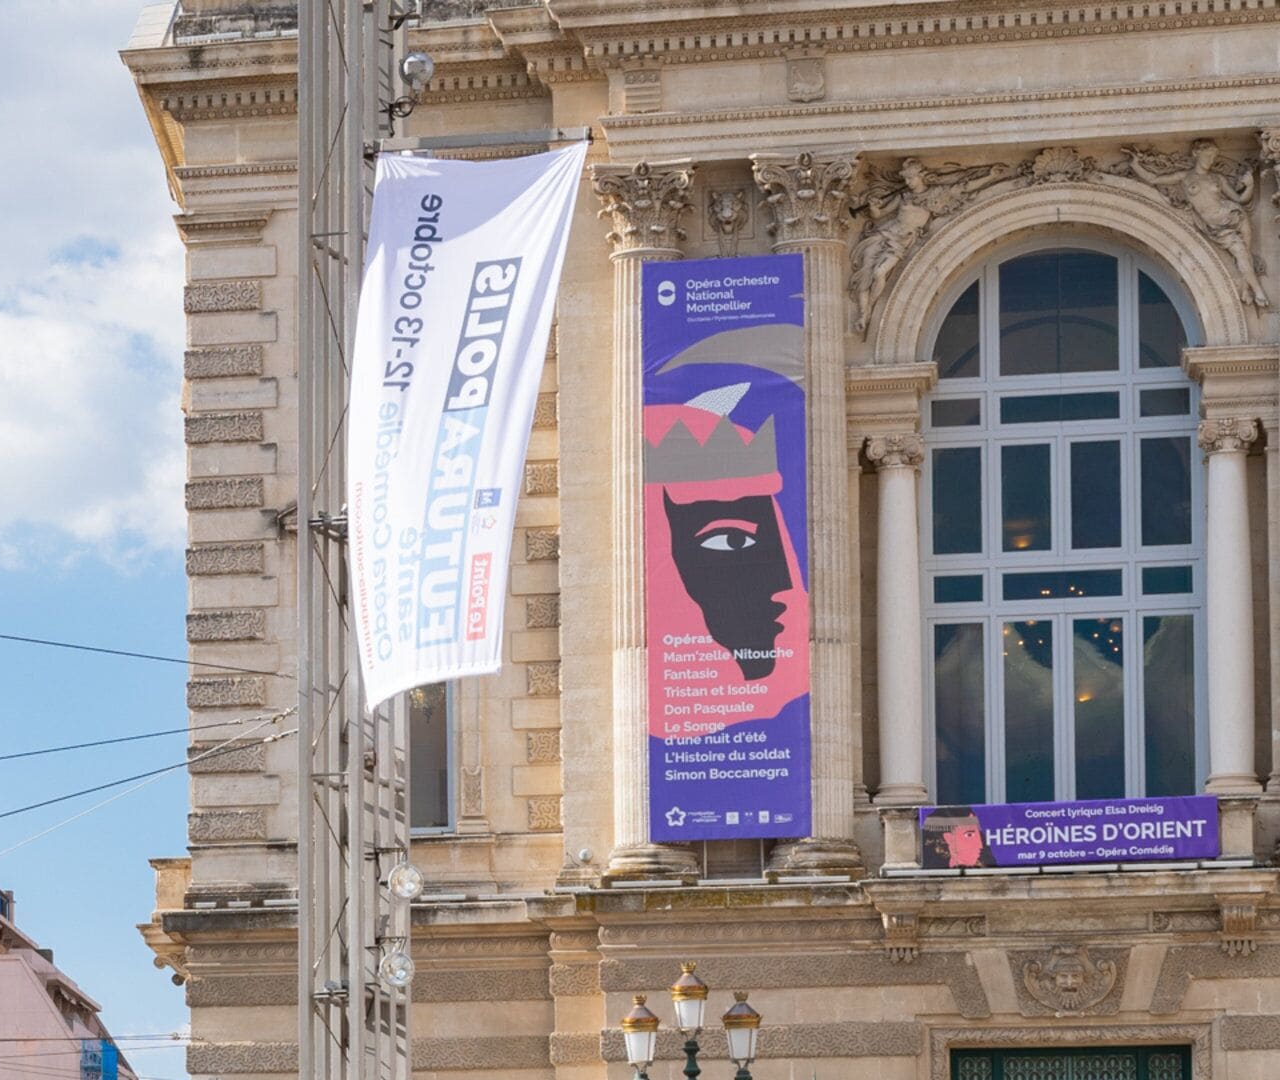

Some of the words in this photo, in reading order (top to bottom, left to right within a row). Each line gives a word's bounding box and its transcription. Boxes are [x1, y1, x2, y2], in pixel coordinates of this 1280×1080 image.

[686, 278, 721, 290] Opéra
[723, 275, 780, 287] Orchestre
[686, 289, 734, 301] National
[686, 301, 752, 313] Montpellier
[663, 634, 714, 647] Opéras
[733, 647, 794, 660] Nitouche
[664, 668, 718, 681] Fantasio
[664, 686, 708, 698] Tristan
[711, 686, 725, 696] et
[728, 684, 768, 695] Isolde
[664, 704, 691, 715] Don
[694, 702, 754, 715] Pasquale
[664, 722, 680, 733] Le
[684, 721, 726, 734] Songe
[705, 733, 730, 745] nuit
[728, 750, 746, 761] du
[749, 748, 791, 761] soldat
[665, 769, 706, 781] Simon
[710, 767, 789, 780] Boccanegra
[1025, 807, 1066, 818] Concert
[1067, 806, 1103, 818] lyrique
[1105, 804, 1127, 816] Elsa
[1128, 803, 1164, 816] Dreisig
[985, 823, 1097, 847] HÉROÏNES
[1017, 851, 1037, 860] mar
[1039, 850, 1045, 859] 9
[1047, 849, 1086, 859] octobre
[1096, 847, 1127, 858] Opéra
[1129, 845, 1175, 856] Comédie
